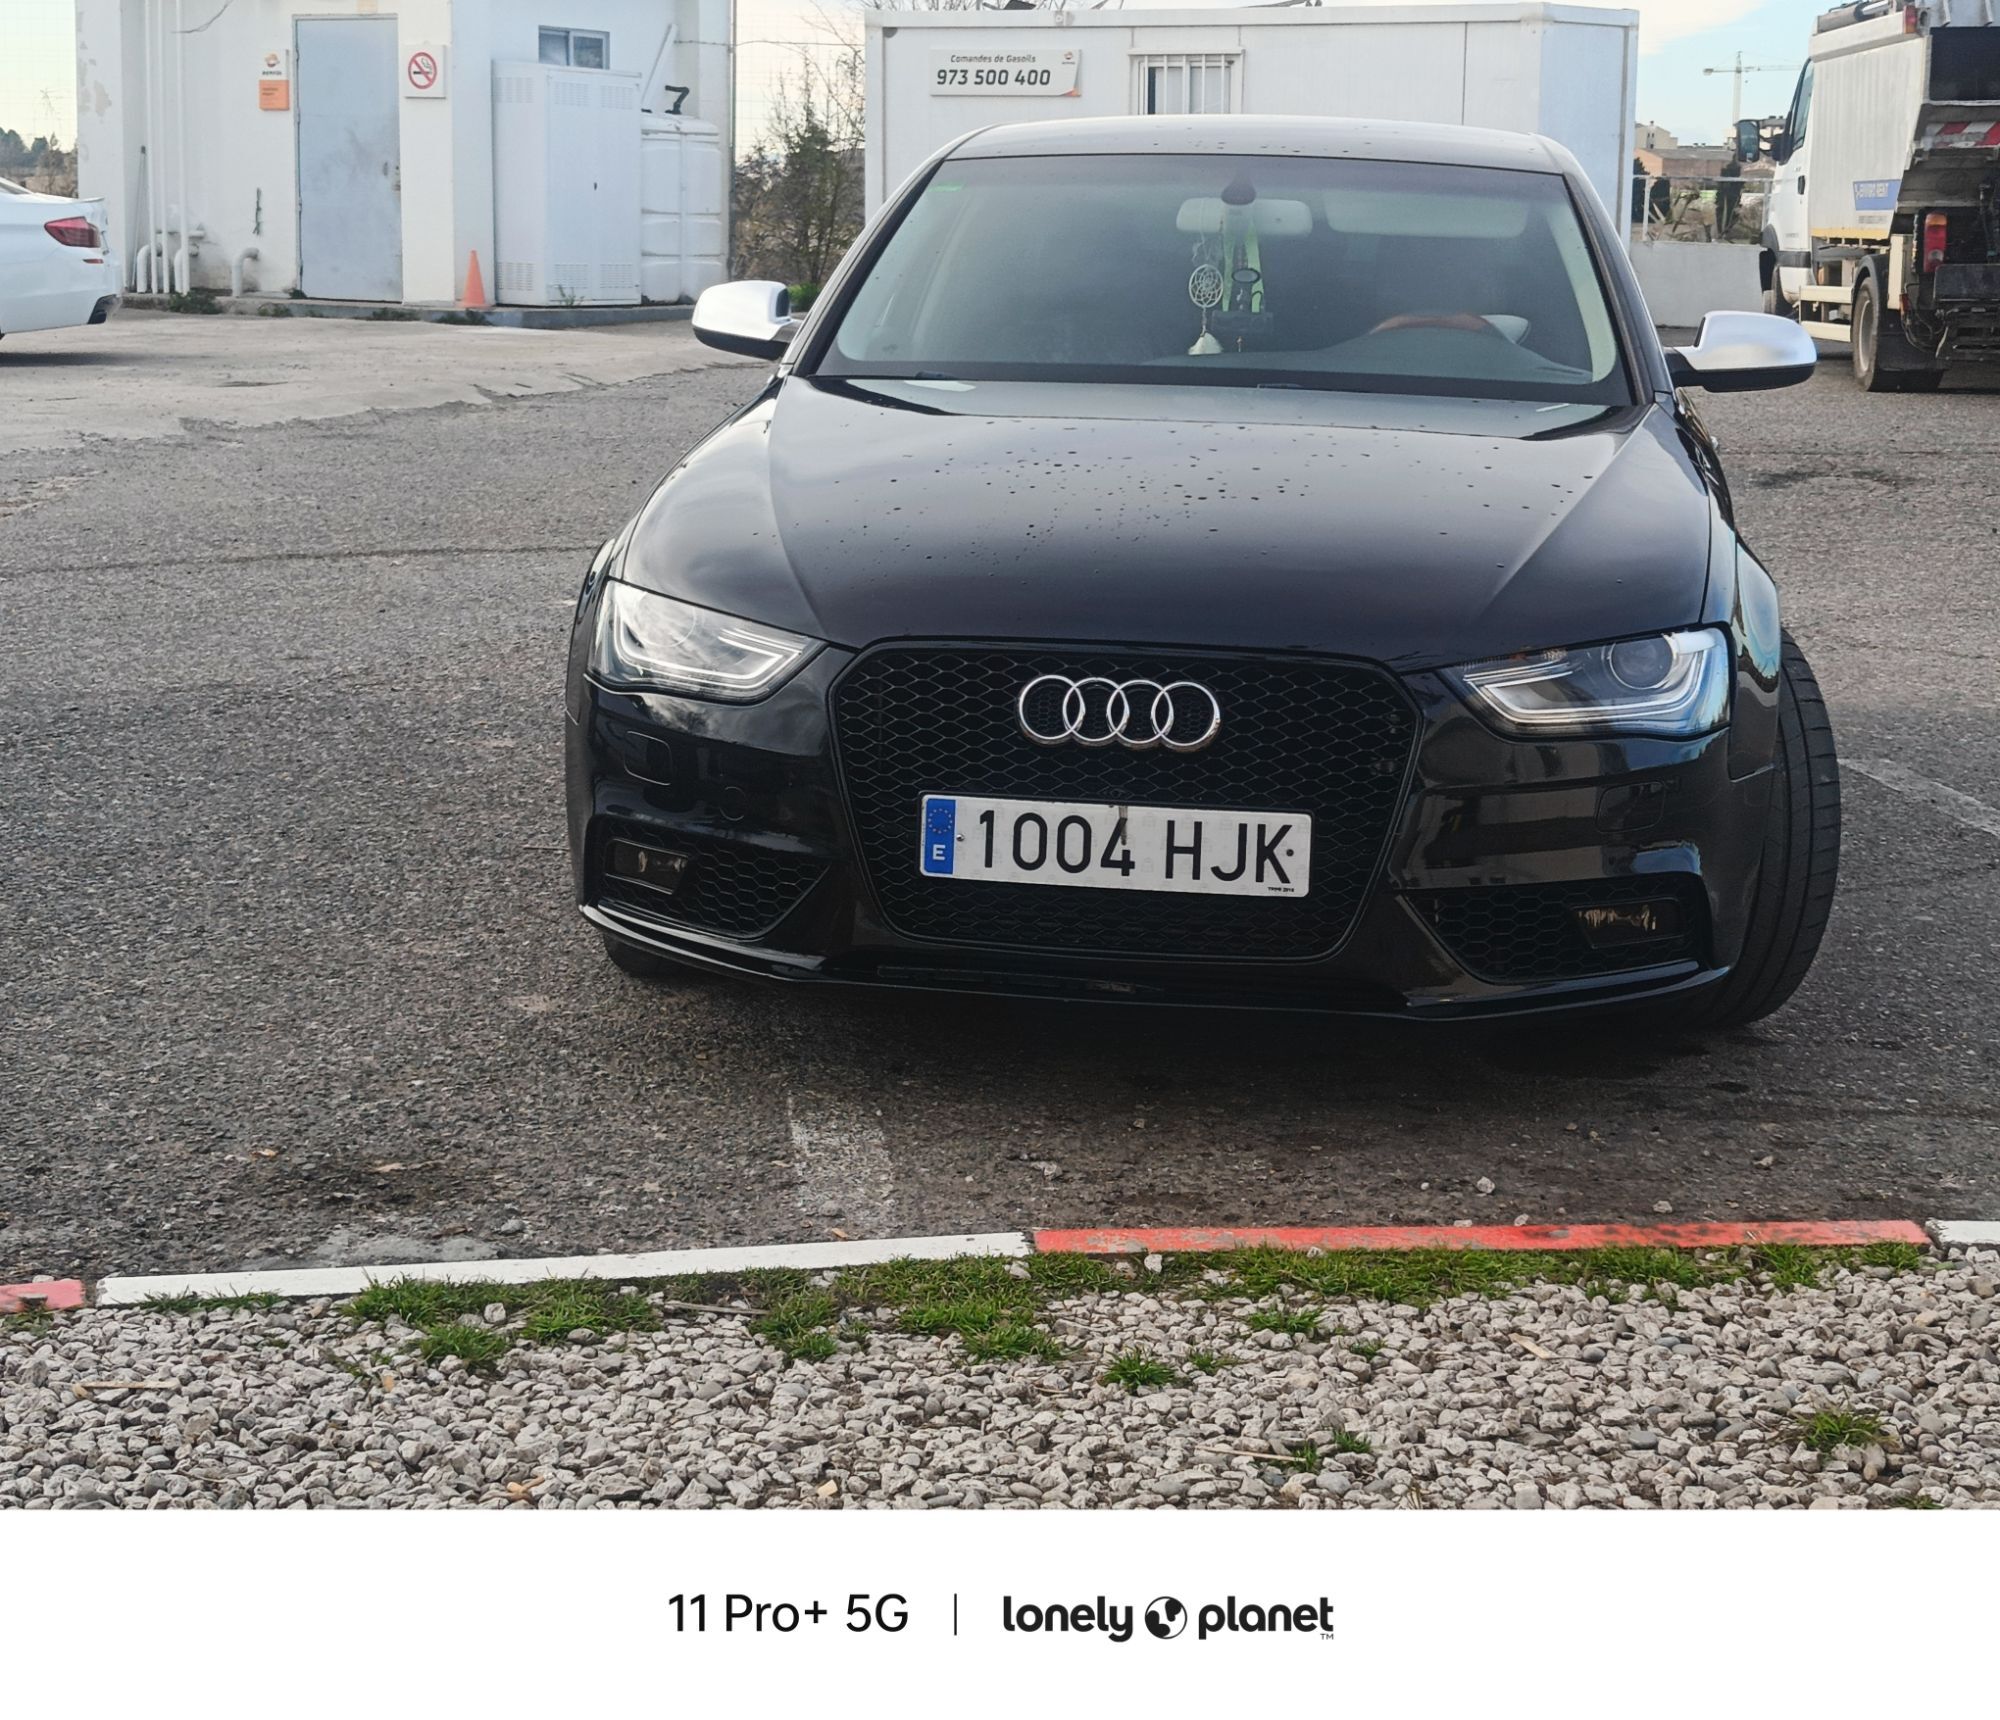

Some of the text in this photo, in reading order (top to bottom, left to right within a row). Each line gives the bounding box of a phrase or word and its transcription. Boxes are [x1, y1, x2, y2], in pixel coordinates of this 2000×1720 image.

[950, 54, 992, 63] Comandes
[994, 54, 1004, 63] de
[936, 69, 1051, 86] 973 500 400
[932, 843, 946, 861] E
[979, 809, 1293, 884] 1004 HJK
